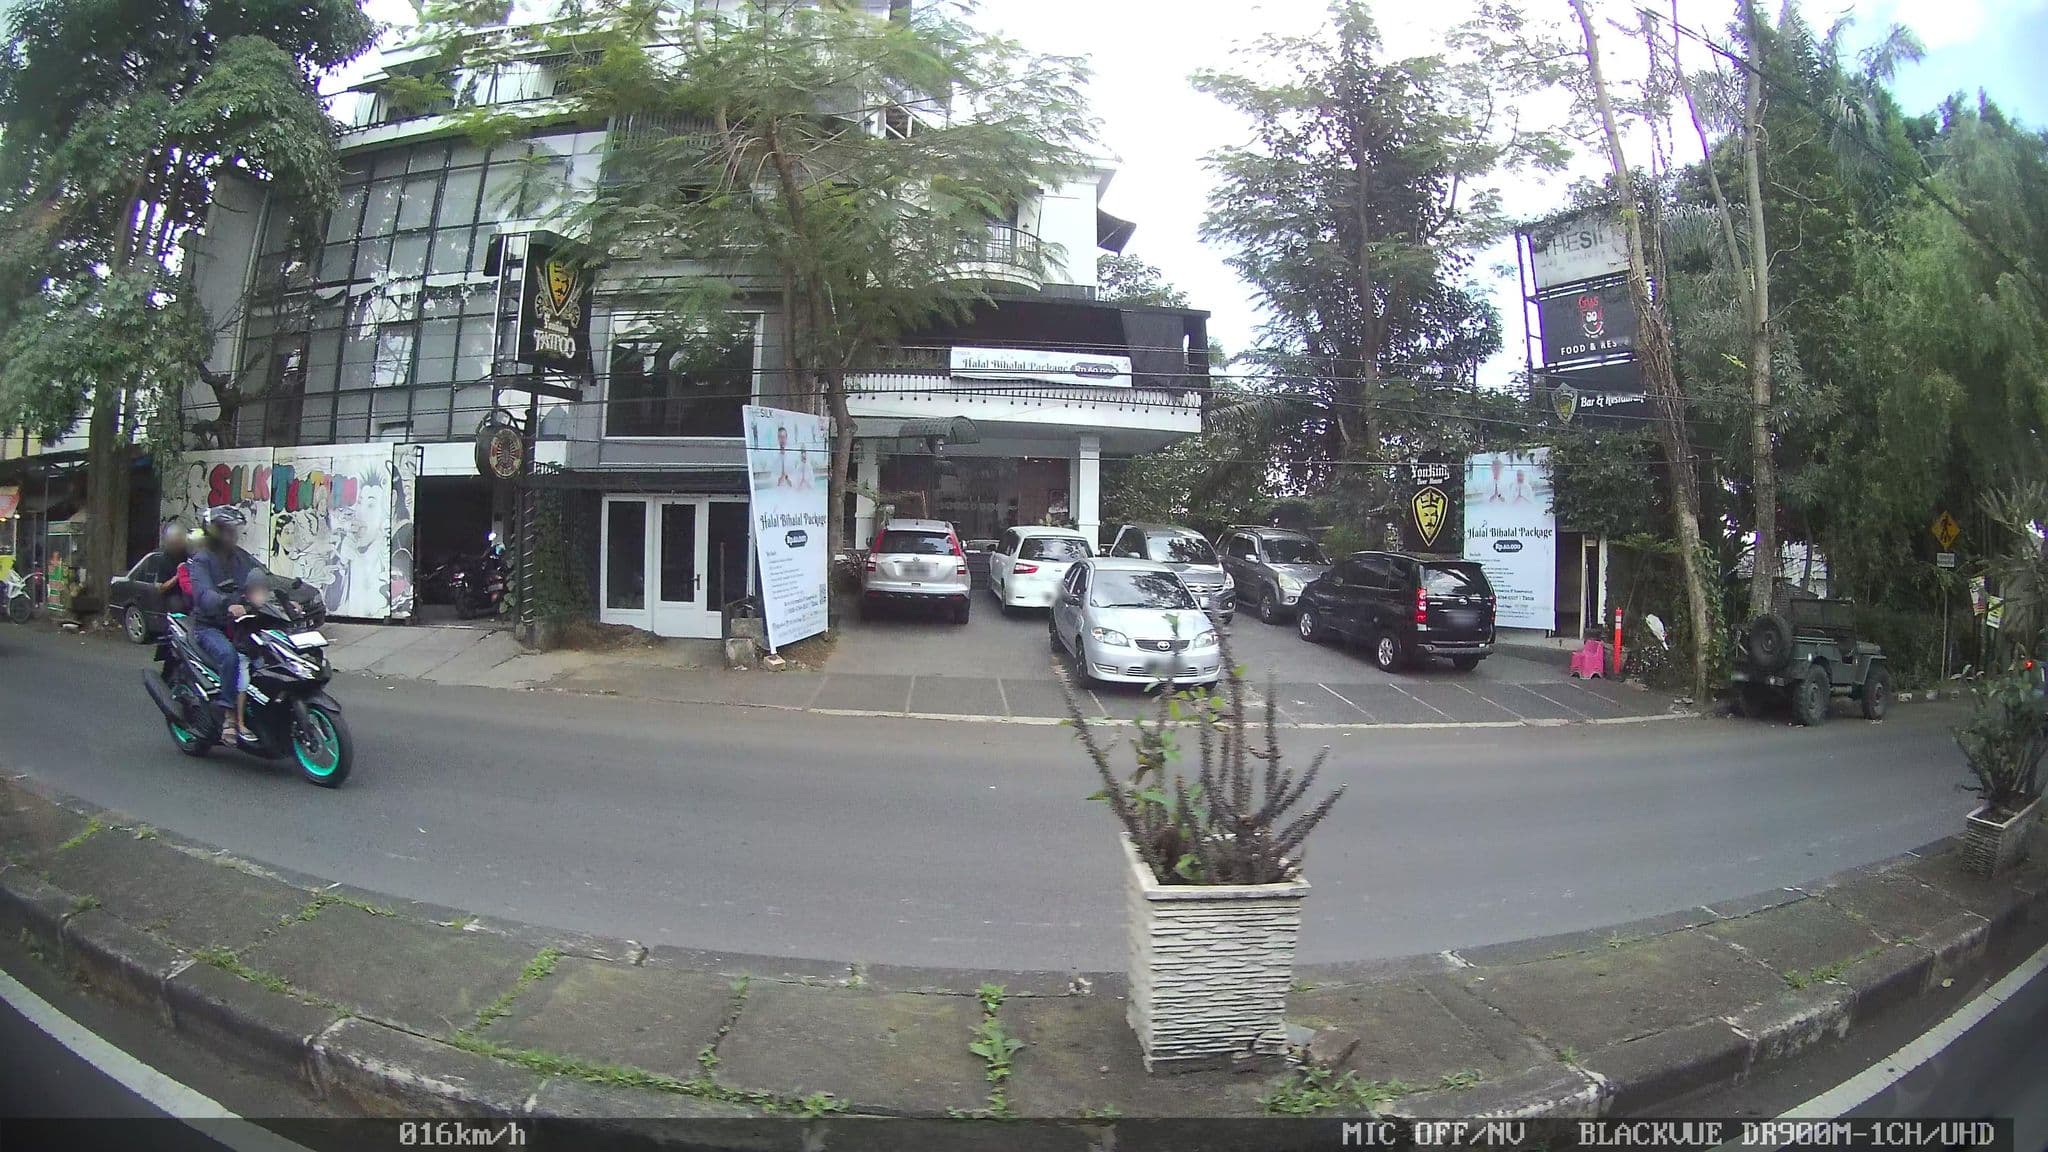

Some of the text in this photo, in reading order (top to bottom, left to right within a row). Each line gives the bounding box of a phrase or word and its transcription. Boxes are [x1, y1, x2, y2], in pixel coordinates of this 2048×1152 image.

[533, 328, 577, 359] TATTOO
[1561, 344, 1586, 356] FOOD
[1589, 342, 1597, 351] &
[962, 358, 990, 371] Halal
[991, 359, 1026, 371] Bihalal
[1580, 396, 1595, 408] Bar
[207, 463, 273, 508] SILK
[760, 511, 779, 531] Halal
[780, 511, 803, 528] Bihalal
[1467, 526, 1553, 539] Halal Bihalal Package
